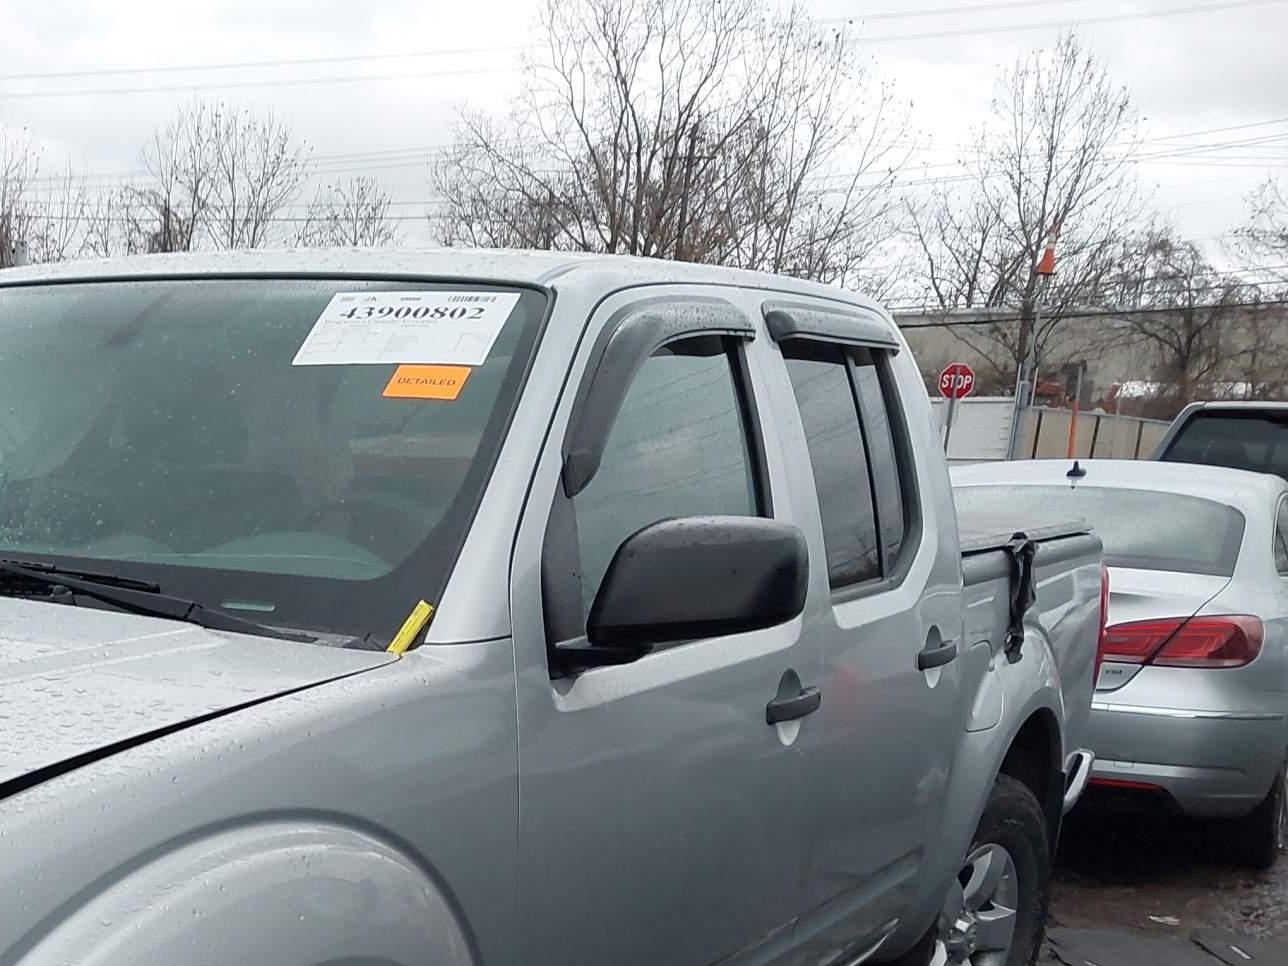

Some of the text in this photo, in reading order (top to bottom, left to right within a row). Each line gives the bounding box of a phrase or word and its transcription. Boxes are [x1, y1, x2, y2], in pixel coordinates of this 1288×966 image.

[339, 306, 485, 320] 43900802
[397, 377, 457, 387] DETAILED
[941, 374, 972, 389] STOP
